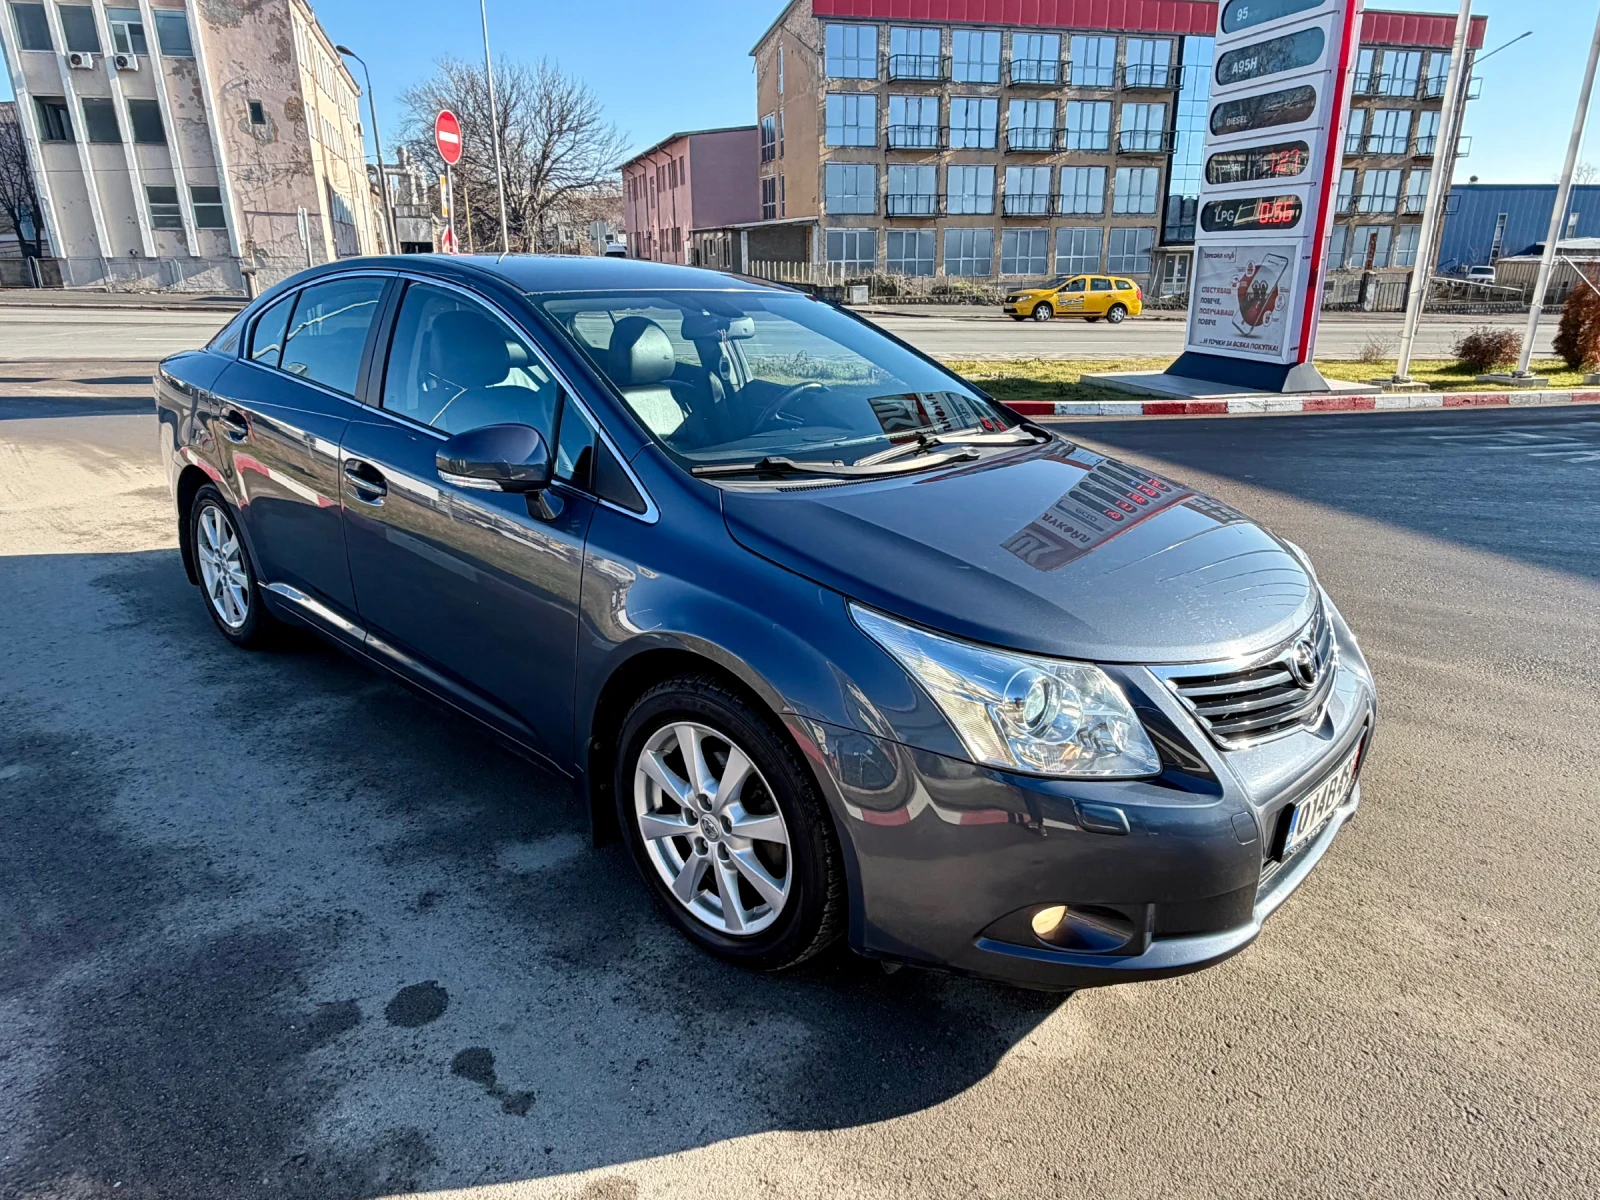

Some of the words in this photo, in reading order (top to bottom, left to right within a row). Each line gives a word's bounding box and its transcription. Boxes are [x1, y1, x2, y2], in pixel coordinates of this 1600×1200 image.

[1236, 6, 1249, 21] 95
[1231, 56, 1258, 74] A95H
[1226, 115, 1248, 126] DIESEL
[1215, 209, 1235, 222] LPG
[1259, 201, 1294, 224] 0.56
[1197, 318, 1217, 326] ПОВЕЧЕ
